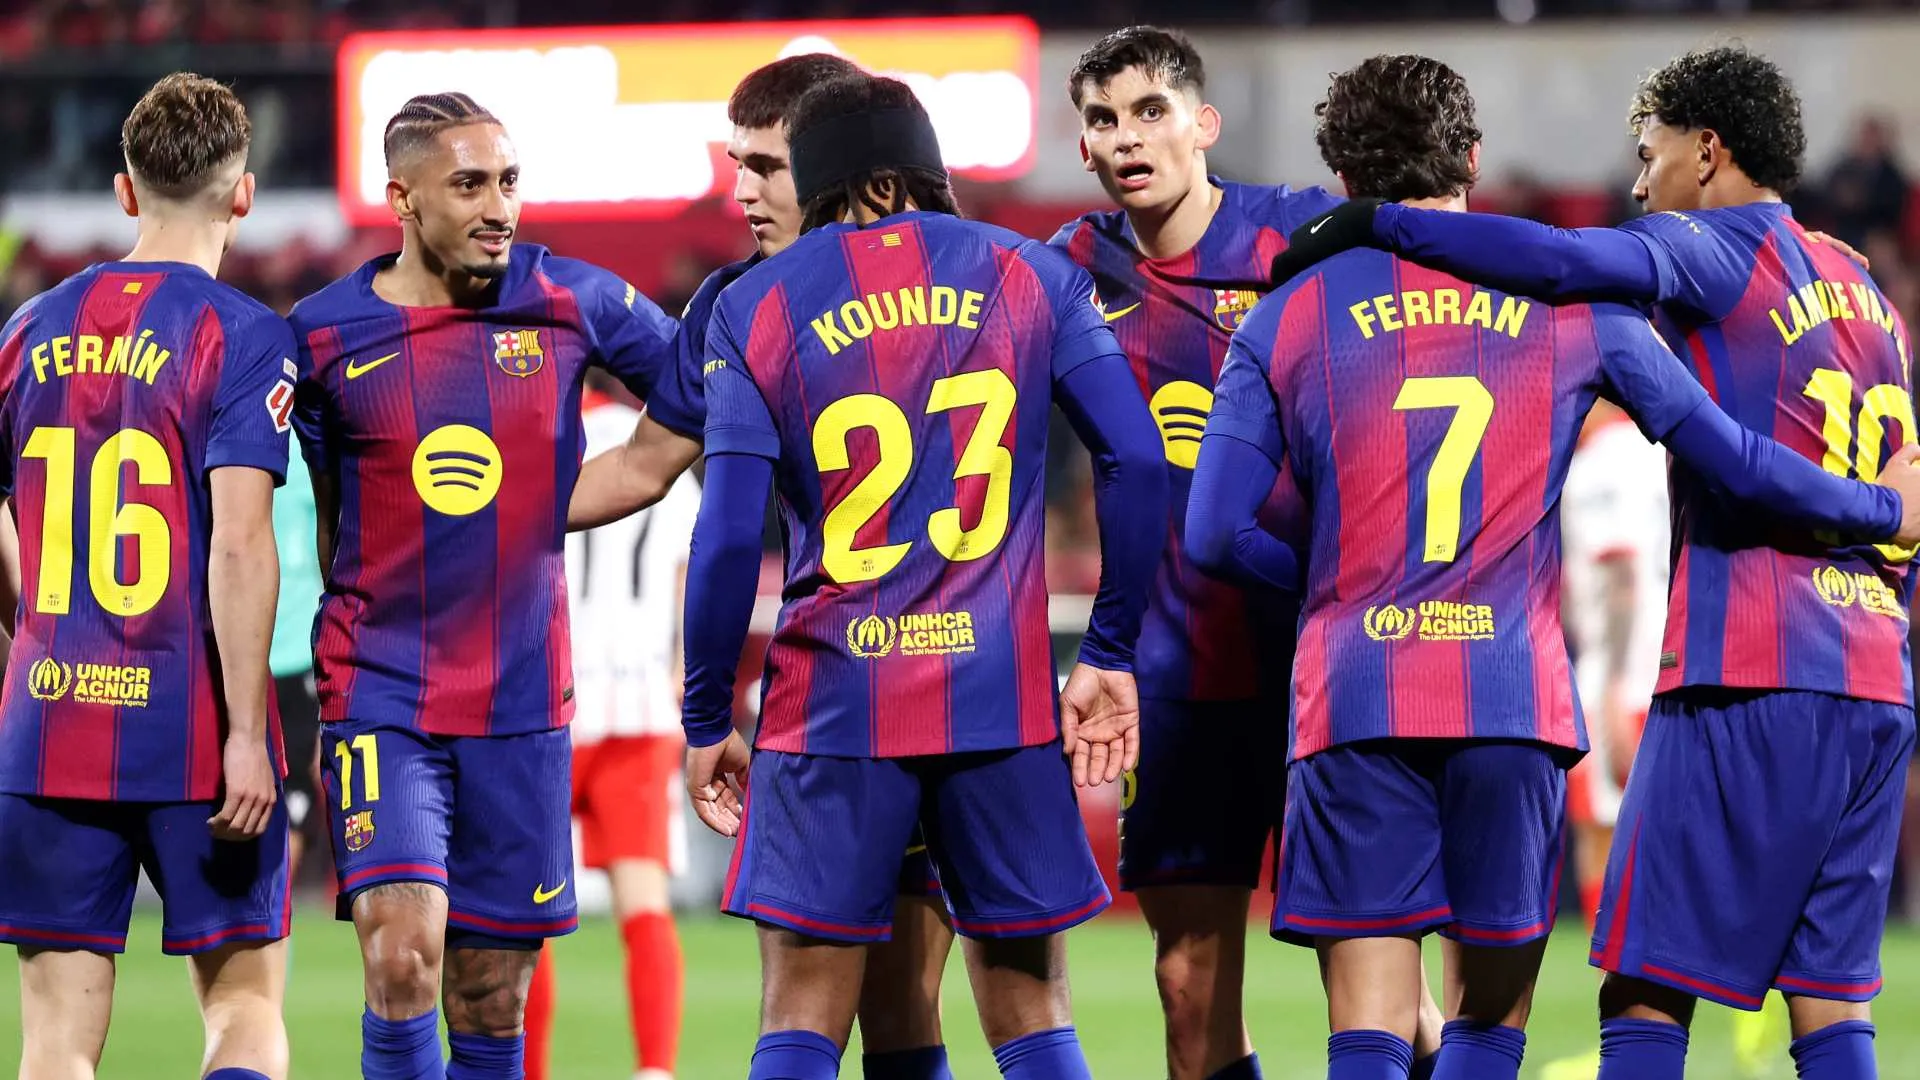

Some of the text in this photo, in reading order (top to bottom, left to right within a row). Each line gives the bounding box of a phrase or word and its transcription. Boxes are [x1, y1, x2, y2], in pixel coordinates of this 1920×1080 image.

[811, 286, 985, 355] KOUNDE
[1349, 288, 1531, 339] FERRAN
[31, 328, 171, 385] FERMÍN
[811, 368, 1018, 584] 23
[1392, 376, 1495, 563] 7
[1802, 368, 1920, 561] 10
[21, 426, 173, 617] 16
[900, 611, 973, 631] UNHCR
[1418, 617, 1495, 634] ACNUR
[1419, 601, 1493, 619] UNHCR
[900, 628, 975, 648] ACNUR
[74, 679, 149, 700] ACNUR
[76, 663, 151, 684] UNHCR
[335, 734, 380, 811] 11
